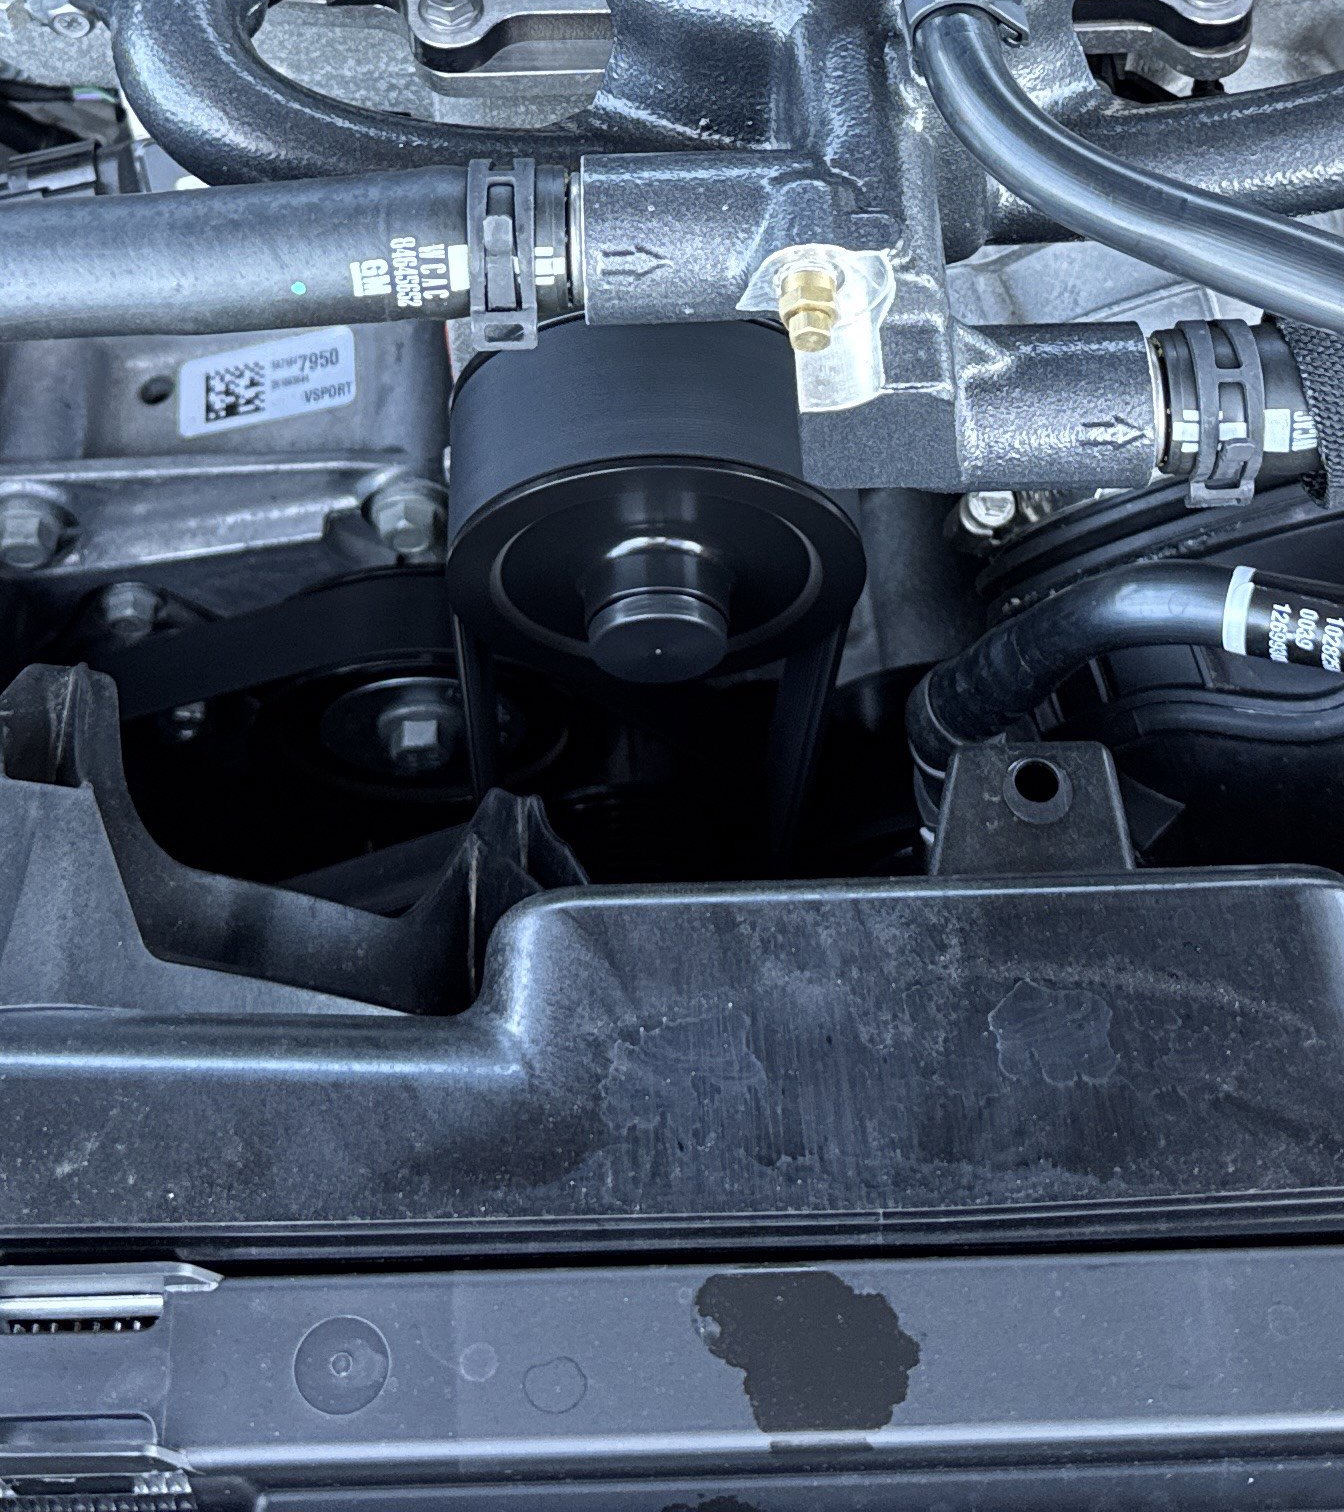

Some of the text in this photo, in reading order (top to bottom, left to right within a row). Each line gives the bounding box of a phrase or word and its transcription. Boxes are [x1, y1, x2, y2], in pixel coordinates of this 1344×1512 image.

[360, 258, 392, 296] GM
[390, 236, 423, 307] 84645652
[304, 381, 353, 404] VSPORT
